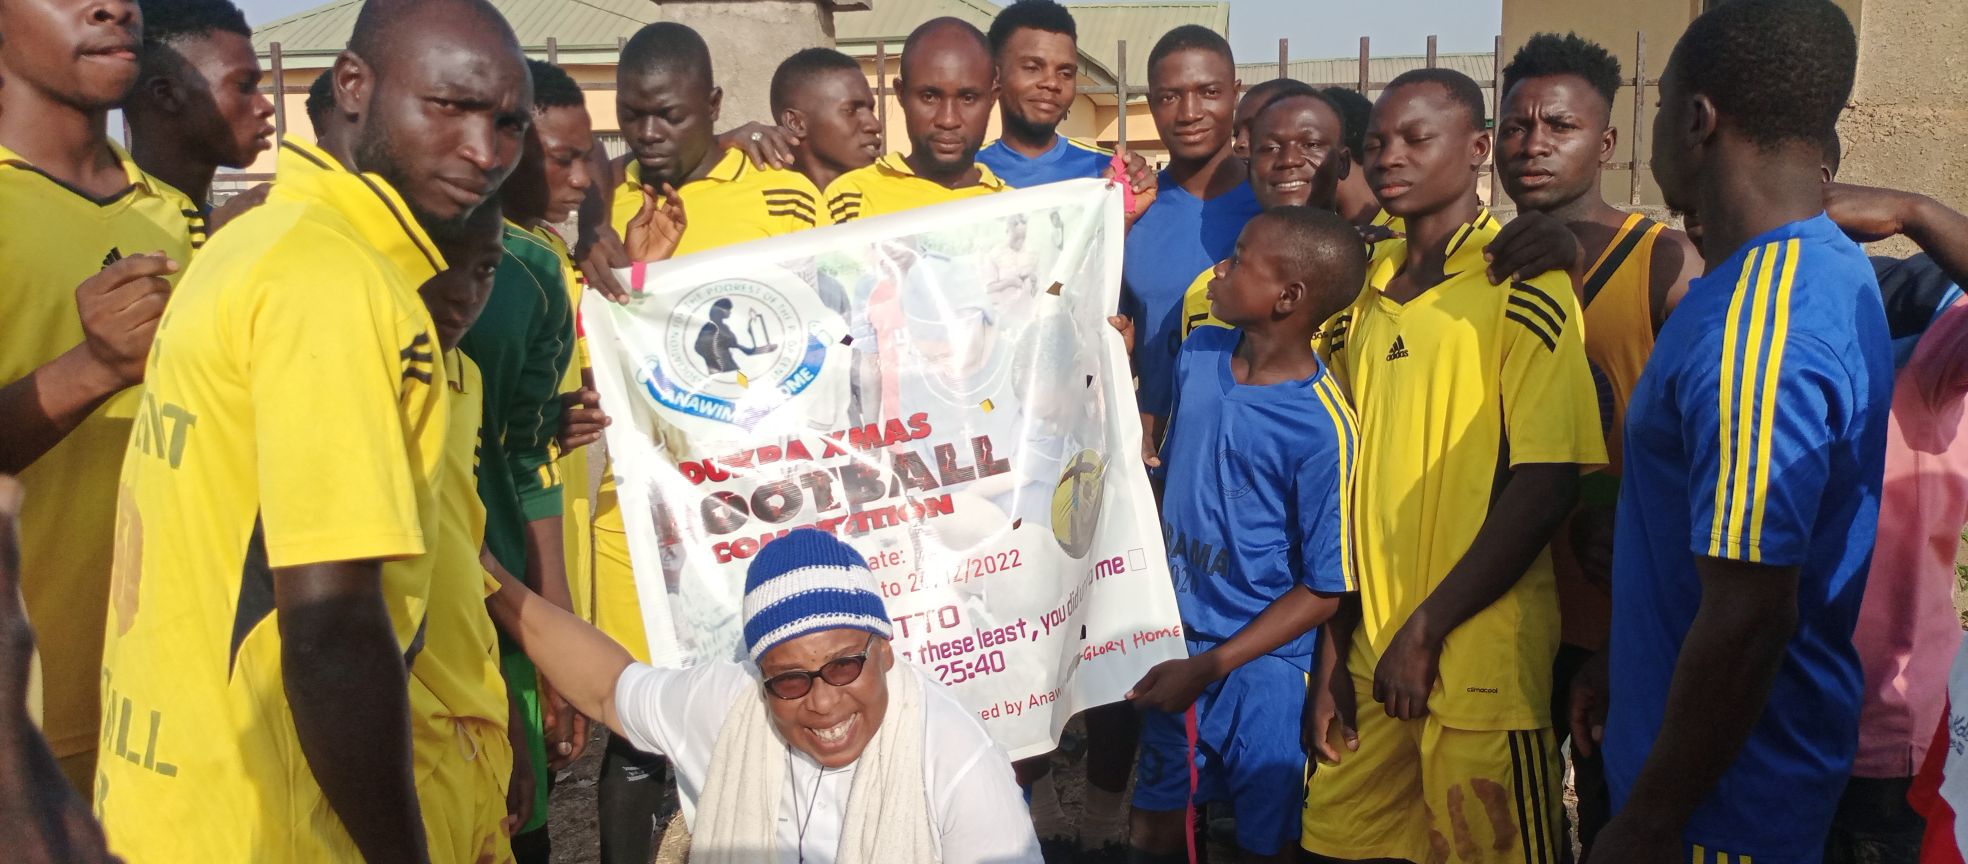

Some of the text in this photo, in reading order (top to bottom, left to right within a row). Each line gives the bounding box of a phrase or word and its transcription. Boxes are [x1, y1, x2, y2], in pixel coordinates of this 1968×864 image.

[1386, 350, 1409, 361] adidas
[819, 412, 932, 459] XMAS
[652, 435, 1011, 545] OOTBALL
[869, 550, 906, 571] ate:
[881, 581, 902, 598] to
[892, 604, 961, 639] TTO
[919, 636, 975, 665] these
[1040, 605, 1066, 635] you
[1095, 556, 1126, 580] me
[934, 649, 1007, 686] 25:40
[978, 703, 1000, 721] ed
[1005, 700, 1023, 717] by
